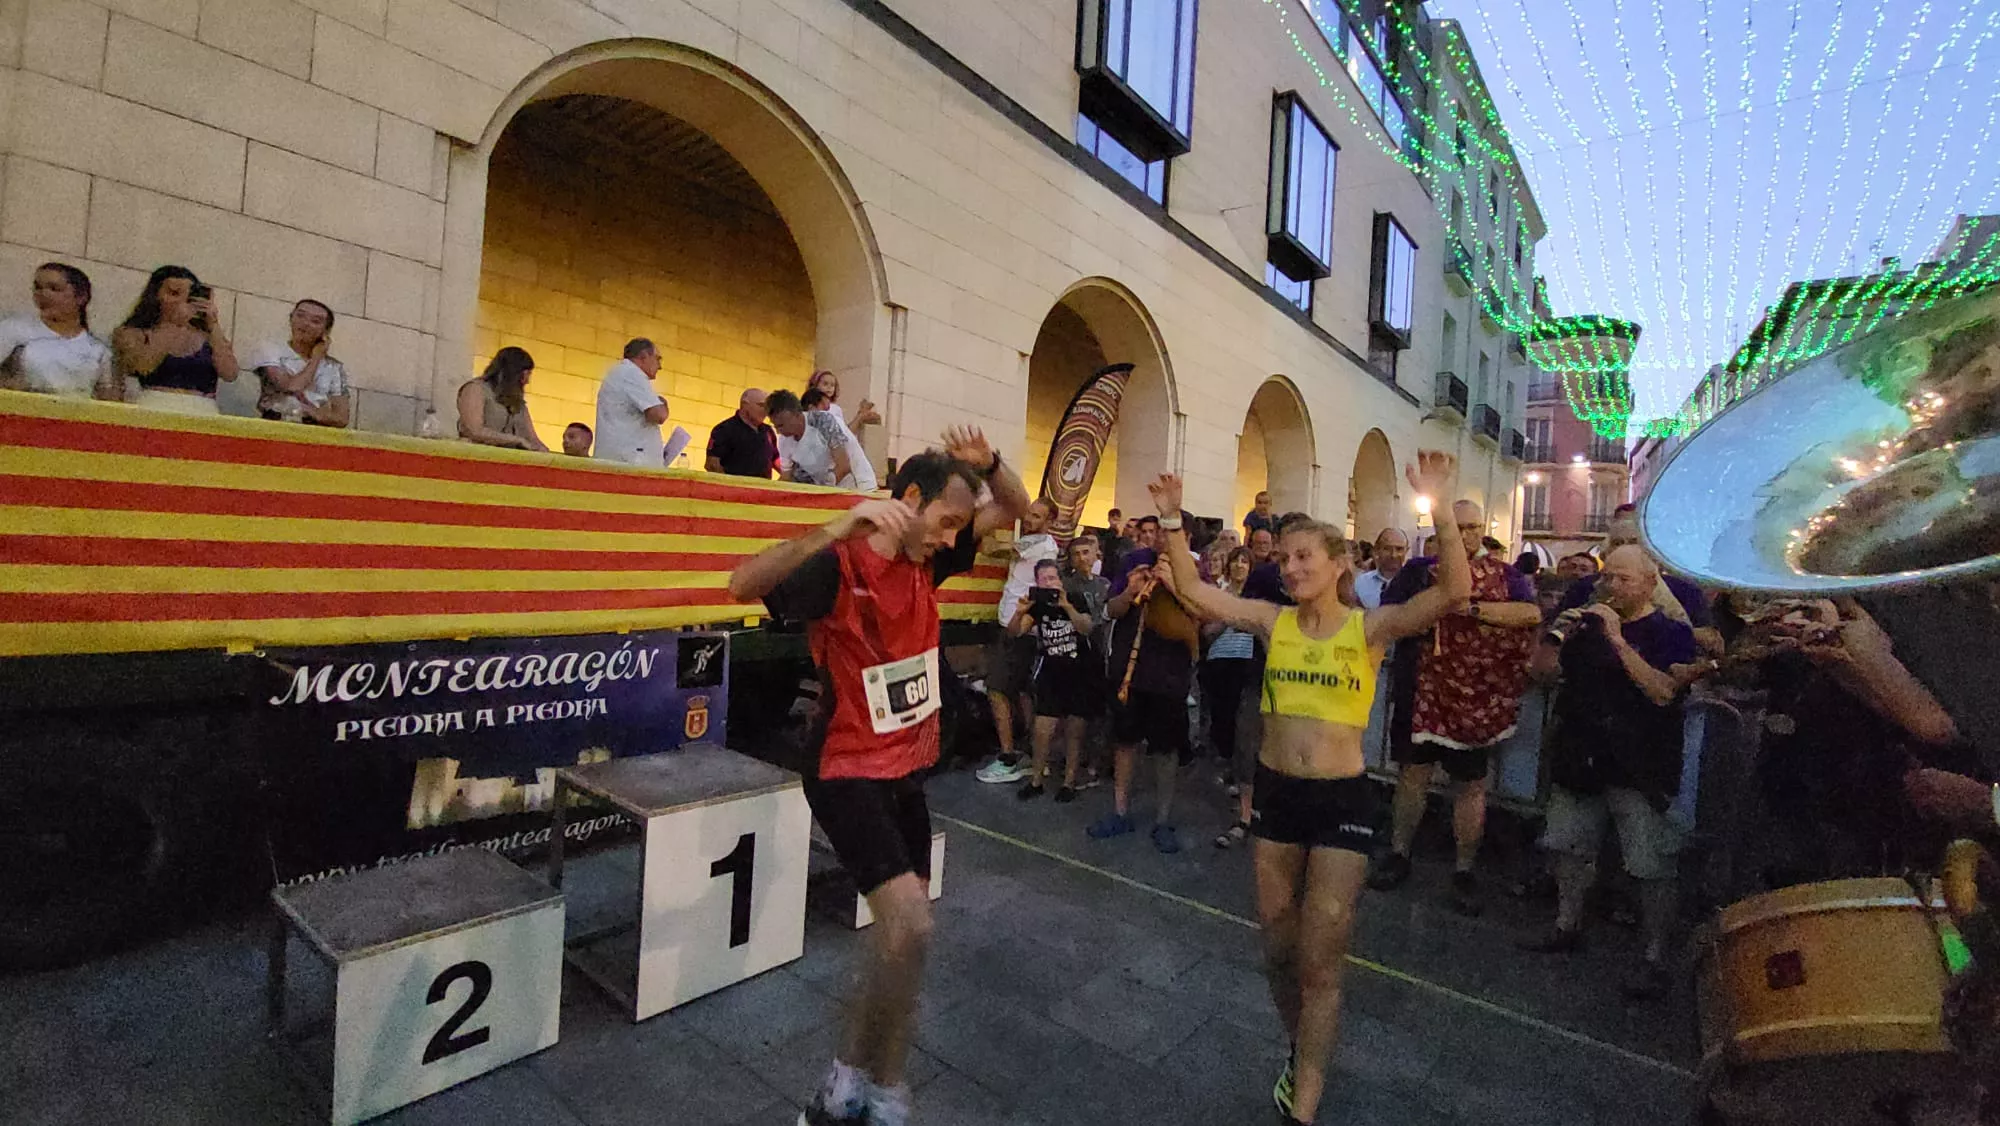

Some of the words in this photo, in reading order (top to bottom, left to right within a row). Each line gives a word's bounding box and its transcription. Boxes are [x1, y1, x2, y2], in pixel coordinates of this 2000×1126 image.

[269, 640, 659, 706] MONTEARAGÓN
[904, 675, 928, 706] 60
[334, 711, 464, 742] PIEDRA
[471, 708, 496, 733] A
[505, 697, 608, 725] PIEDRA
[709, 832, 756, 949] 1
[421, 960, 492, 1066] 2
